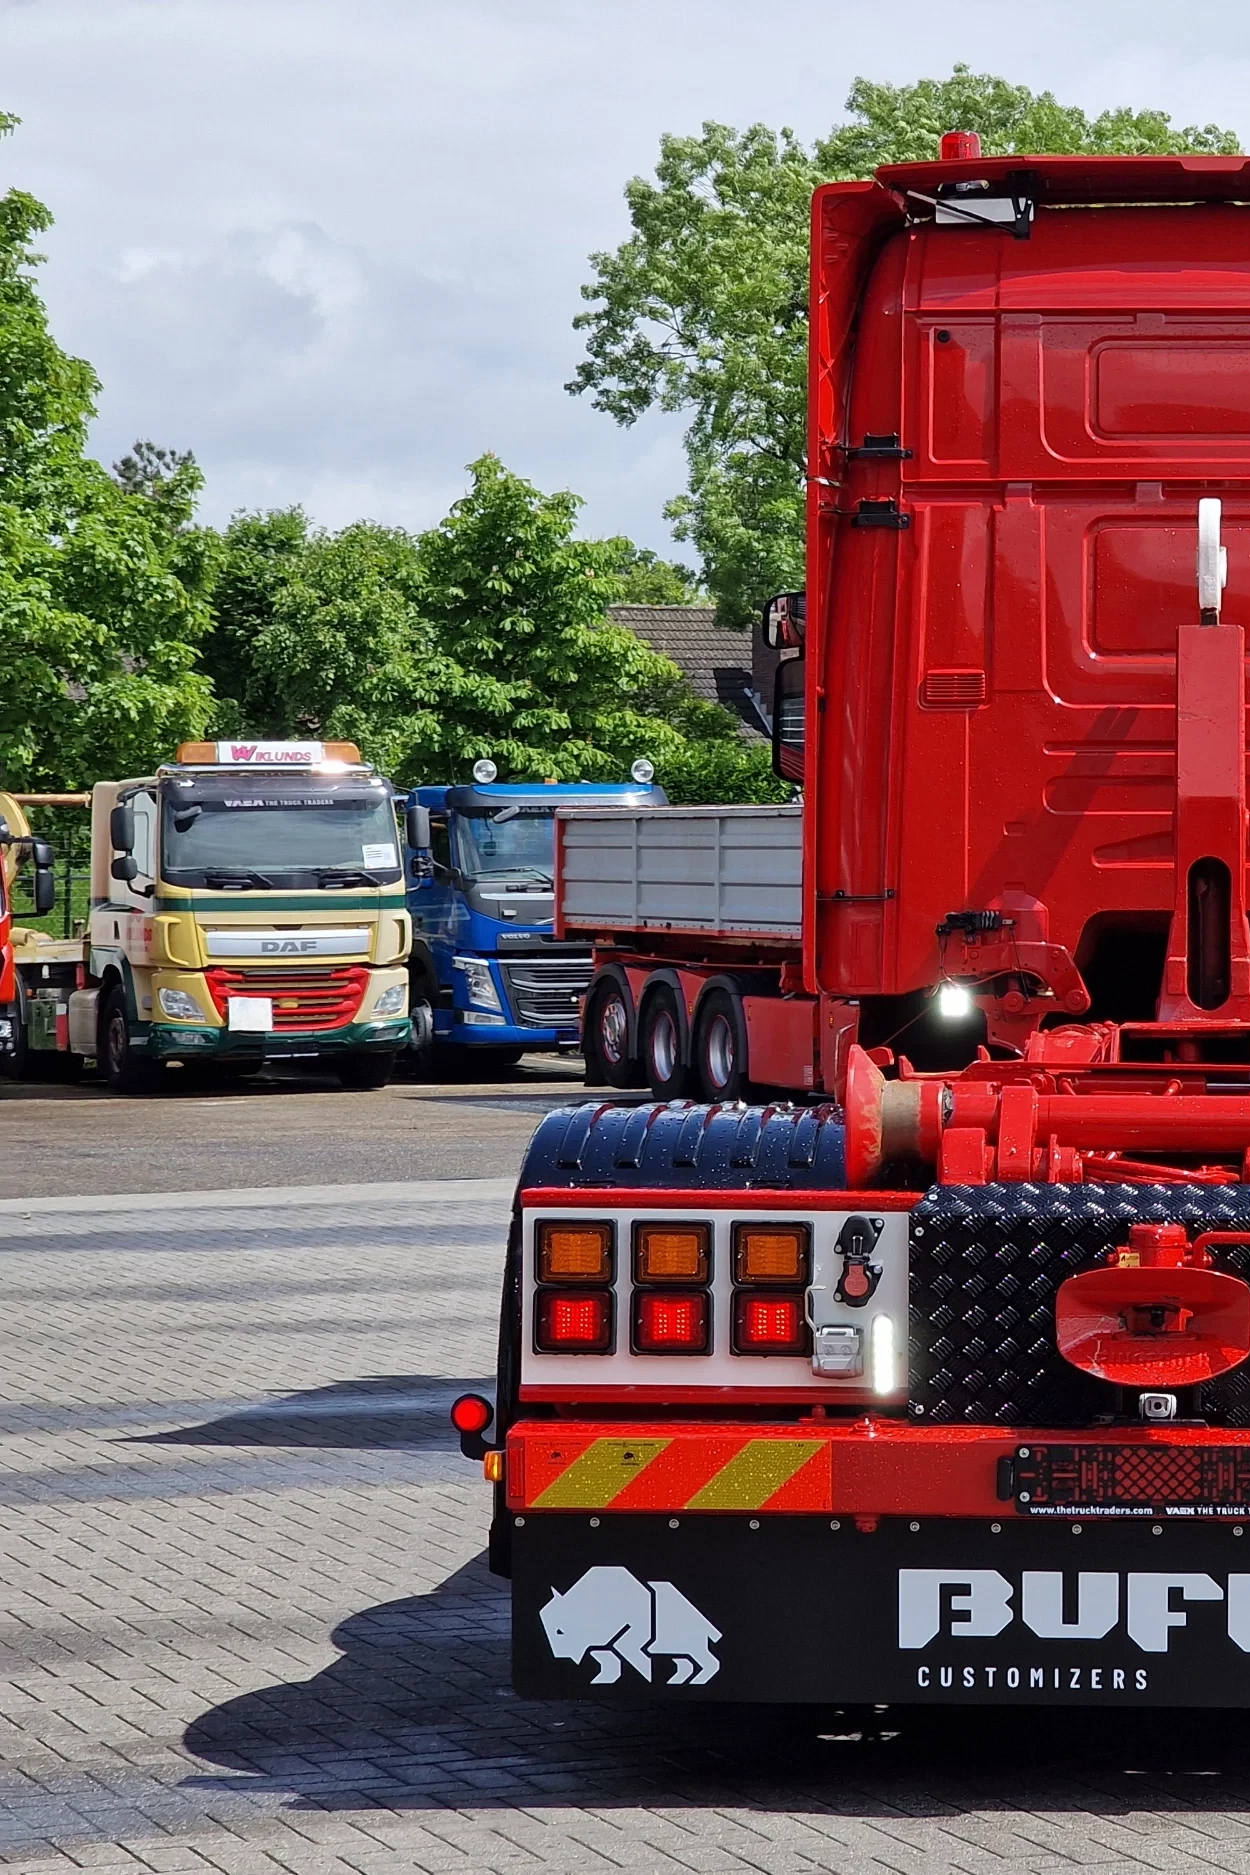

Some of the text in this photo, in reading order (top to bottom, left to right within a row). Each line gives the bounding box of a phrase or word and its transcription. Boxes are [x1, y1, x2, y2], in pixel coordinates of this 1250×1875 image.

[231, 745, 312, 762] WIKLUNDS
[261, 941, 318, 953] DAF
[1030, 1505, 1153, 1516] www.thetrucktraders.com
[1197, 1507, 1214, 1515] THE
[1216, 1507, 1245, 1515] TRUCK
[917, 1665, 1149, 1691] CUSTOMIZERS
